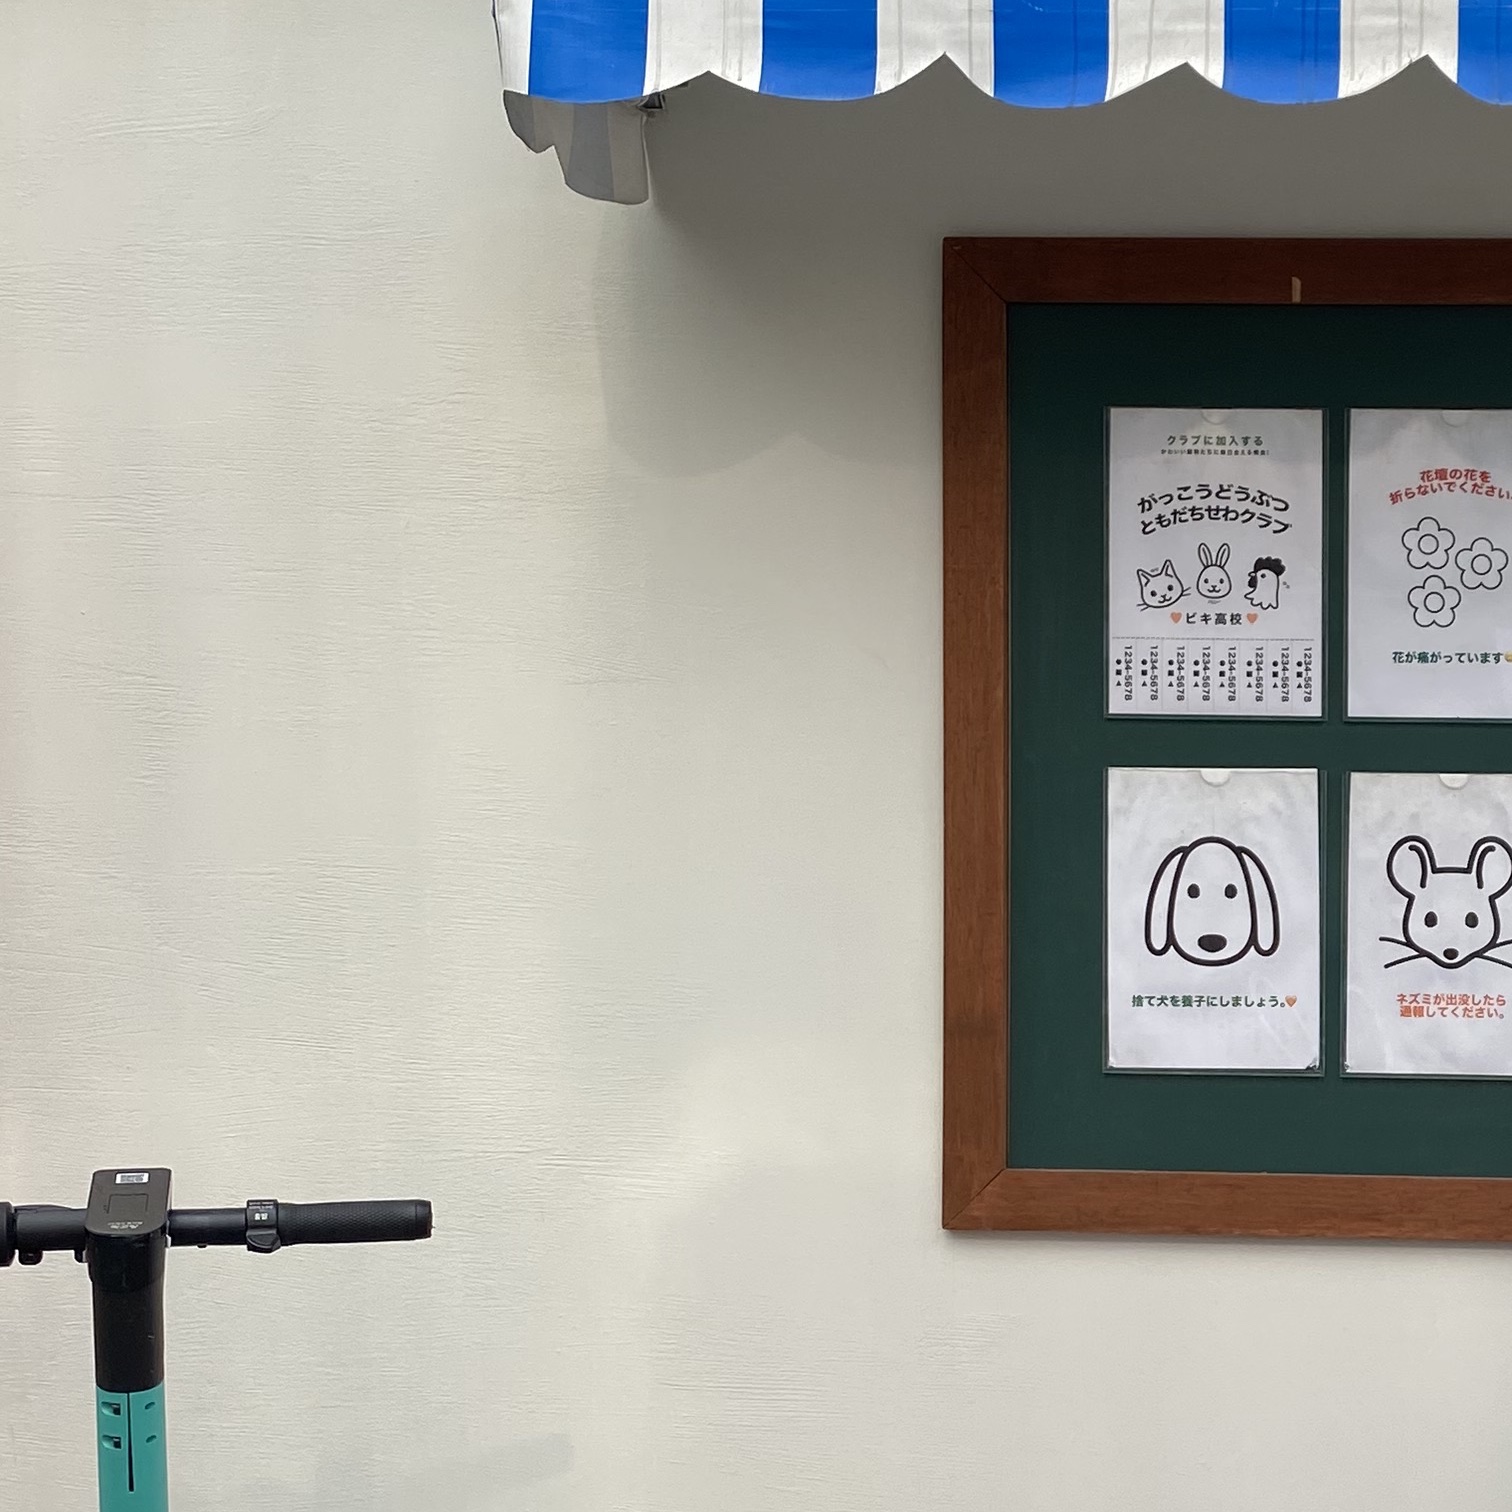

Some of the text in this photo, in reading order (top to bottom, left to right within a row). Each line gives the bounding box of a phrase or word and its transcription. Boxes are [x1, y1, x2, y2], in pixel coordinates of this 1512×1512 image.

[1167, 435, 1263, 446] クラブに加入する
[1136, 483, 1291, 514] がっこうどうぶつ
[1419, 468, 1492, 483] 花壇の花を
[1140, 505, 1293, 536] ともだちせわクラブ
[1124, 646, 1132, 700] 1234-5678
[1150, 646, 1158, 700] 1234-5678
[1177, 646, 1185, 701] 1234-5678
[1202, 646, 1210, 701] 1234-5678
[1228, 646, 1236, 702] 1234-5678
[1255, 646, 1264, 702] 1234-5678
[1281, 647, 1289, 702] 1234-5678
[1304, 647, 1312, 702] 1234-5678
[1396, 993, 1507, 1006] ネズミが出没したら
[1399, 1005, 1505, 1019] 通報してください。
